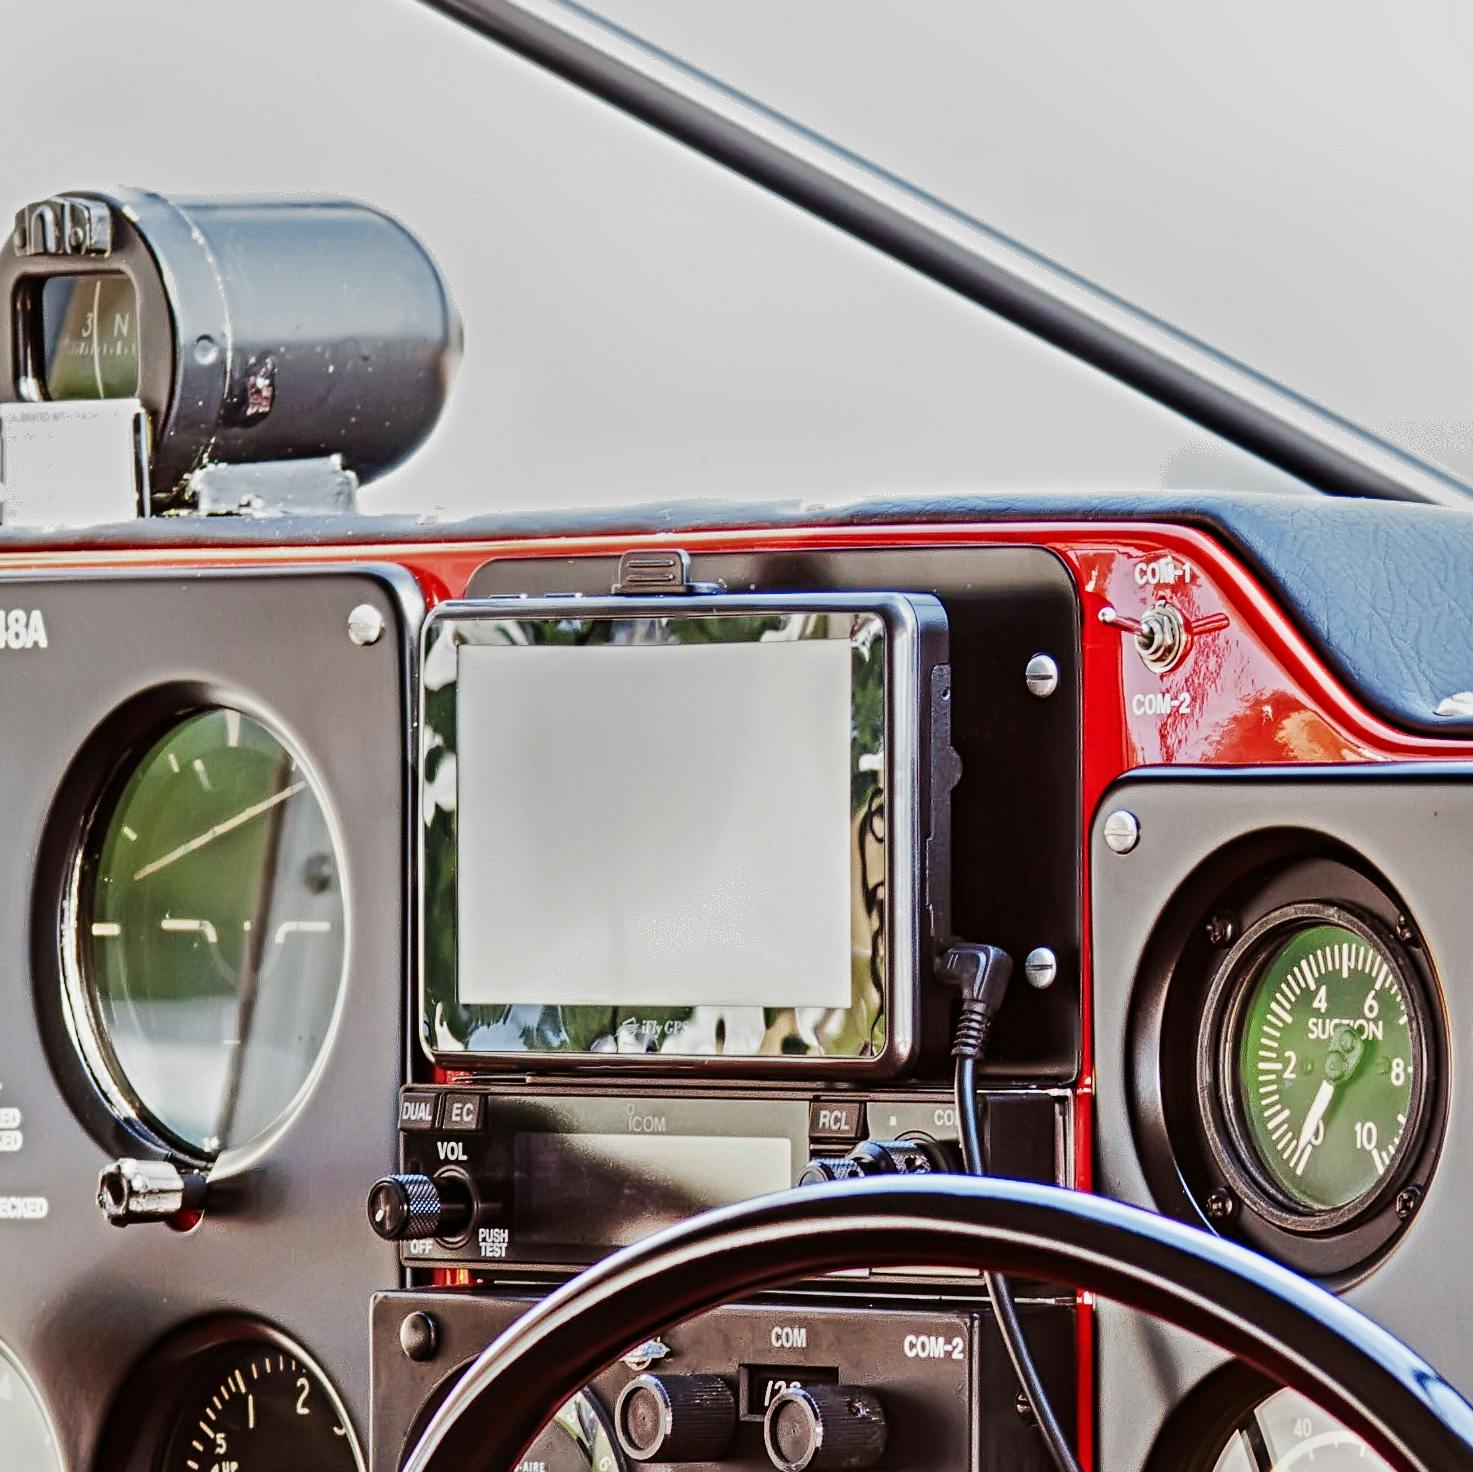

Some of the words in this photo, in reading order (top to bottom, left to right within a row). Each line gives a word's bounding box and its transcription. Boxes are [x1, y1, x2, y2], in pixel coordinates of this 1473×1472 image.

[113, 312, 129, 337] N
[1134, 557, 1192, 585] COM-1
[1132, 693, 1191, 716] COM-2
[1312, 985, 1327, 1014] 4
[1363, 989, 1379, 1019] 6
[641, 1018, 663, 1035] iFly
[1282, 1050, 1297, 1079] 2
[1390, 1057, 1405, 1087] 8
[402, 1102, 433, 1121] DUAL
[451, 1102, 474, 1122] EC
[818, 1110, 849, 1131] RCL
[1355, 1121, 1378, 1151] 10
[437, 1141, 468, 1161] VOL
[478, 1229, 509, 1242] PUSH
[410, 1240, 433, 1255] OFF
[479, 1242, 508, 1257] TEST
[770, 1325, 808, 1348] COM
[903, 1333, 965, 1361] COM-2
[296, 1377, 311, 1415] 2
[1293, 1417, 1313, 1438] 40
[214, 1433, 228, 1456] 5
